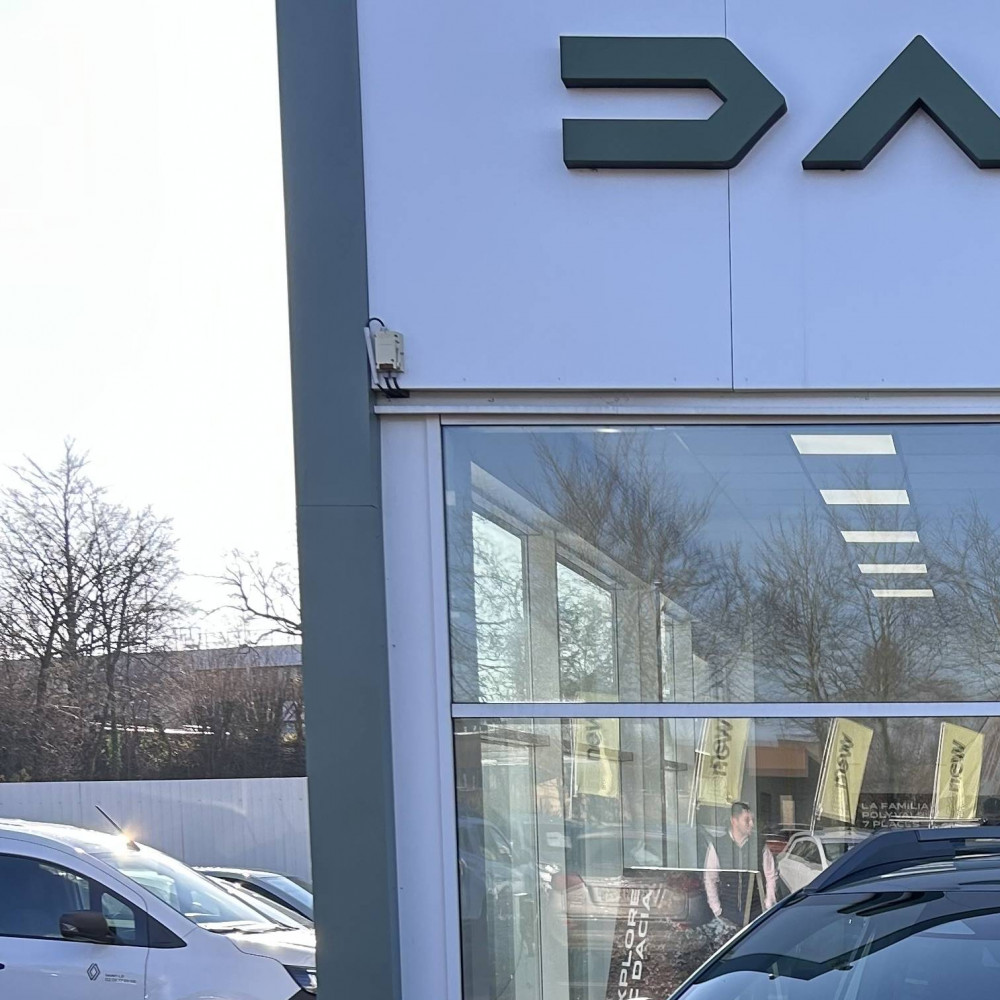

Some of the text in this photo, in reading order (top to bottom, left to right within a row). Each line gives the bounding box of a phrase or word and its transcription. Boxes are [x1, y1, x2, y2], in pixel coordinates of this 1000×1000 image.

[861, 802, 878, 810] LA
[862, 820, 870, 828] 7
[632, 889, 653, 980] DACIA
